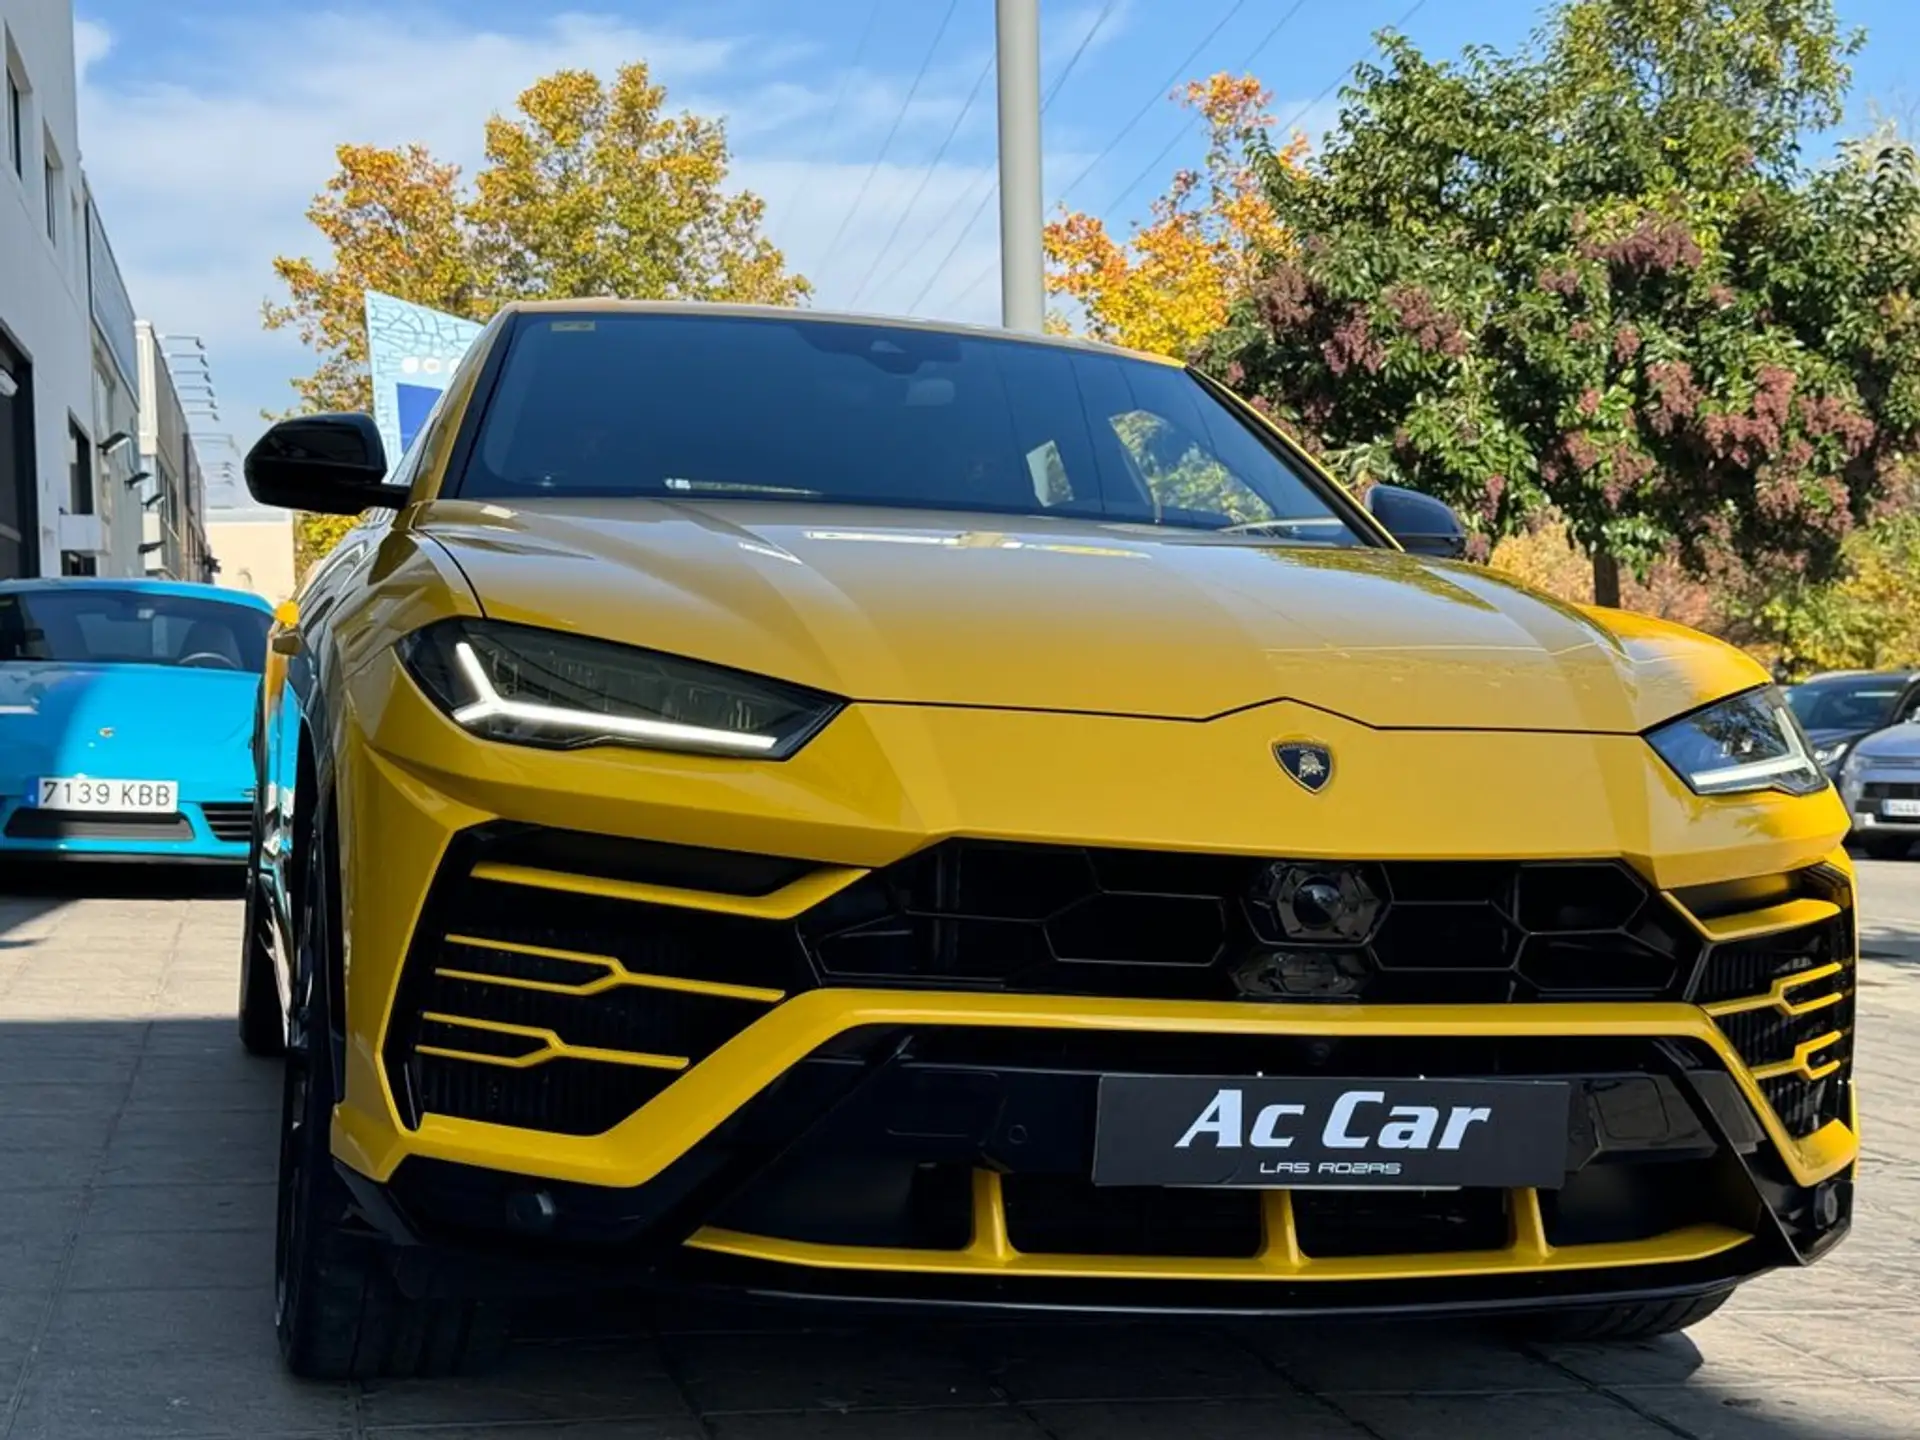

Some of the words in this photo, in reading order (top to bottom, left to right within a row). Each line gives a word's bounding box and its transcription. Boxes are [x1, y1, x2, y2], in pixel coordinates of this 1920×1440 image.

[43, 781, 110, 805] 7139
[121, 783, 171, 806] KBB
[1174, 1089, 1306, 1148] Ac
[1322, 1091, 1492, 1150] Car
[1259, 1162, 1311, 1174] LAS
